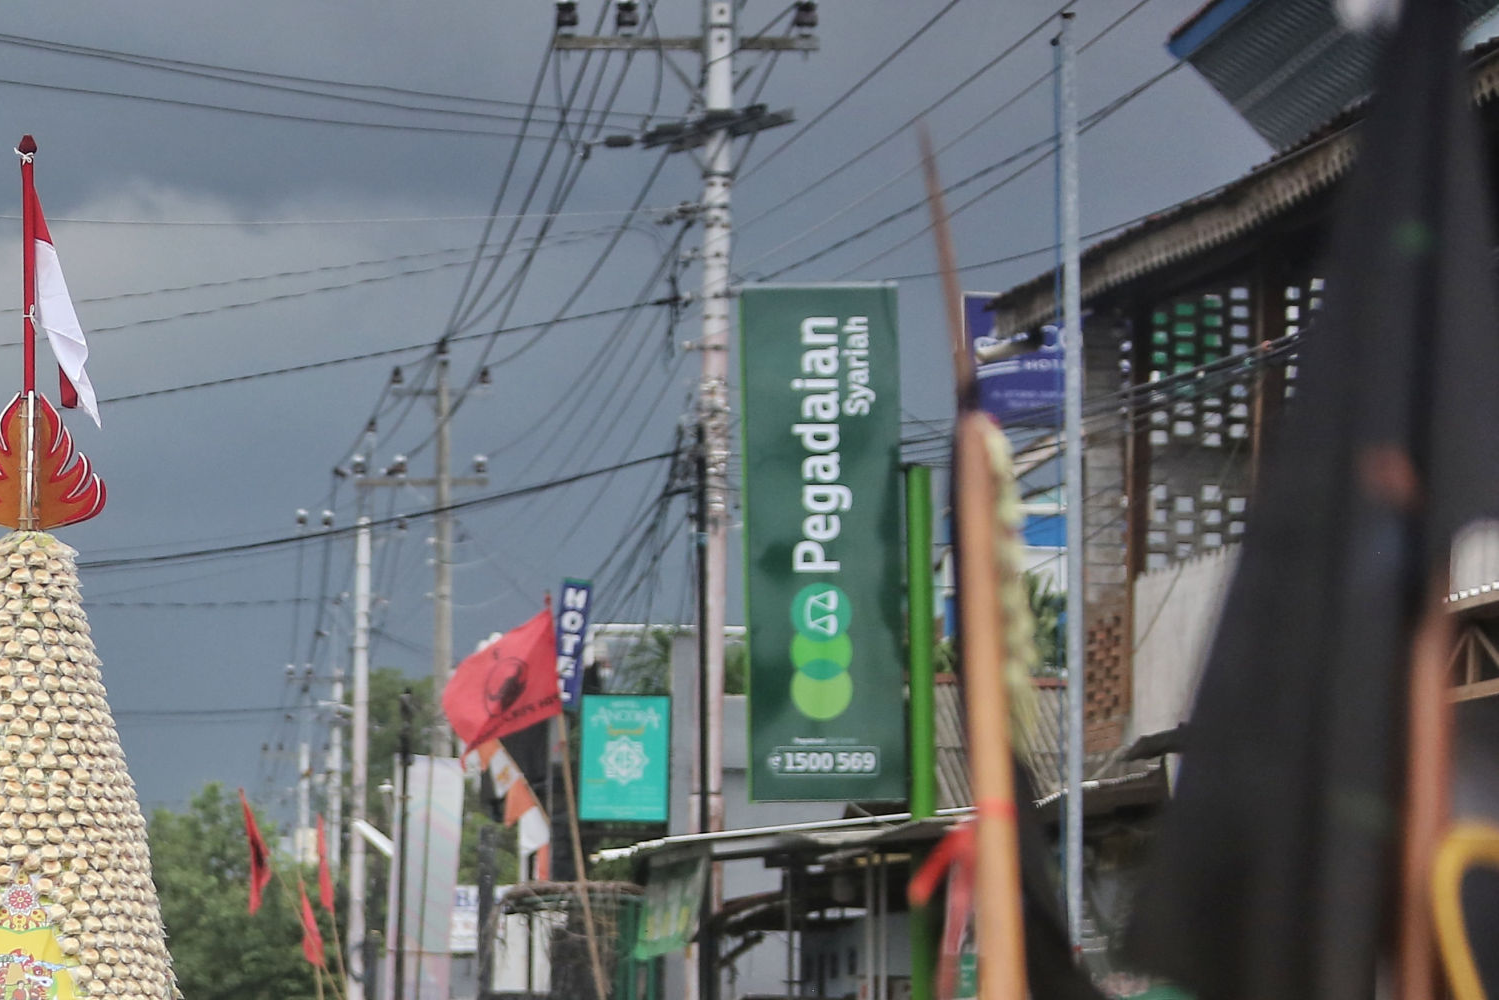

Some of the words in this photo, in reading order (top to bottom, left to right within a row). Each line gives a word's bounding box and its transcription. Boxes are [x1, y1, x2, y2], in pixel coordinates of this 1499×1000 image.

[842, 315, 877, 417] Syariah
[790, 315, 853, 573] Pegadaian
[784, 751, 835, 773] 1500
[835, 751, 877, 773] 569
